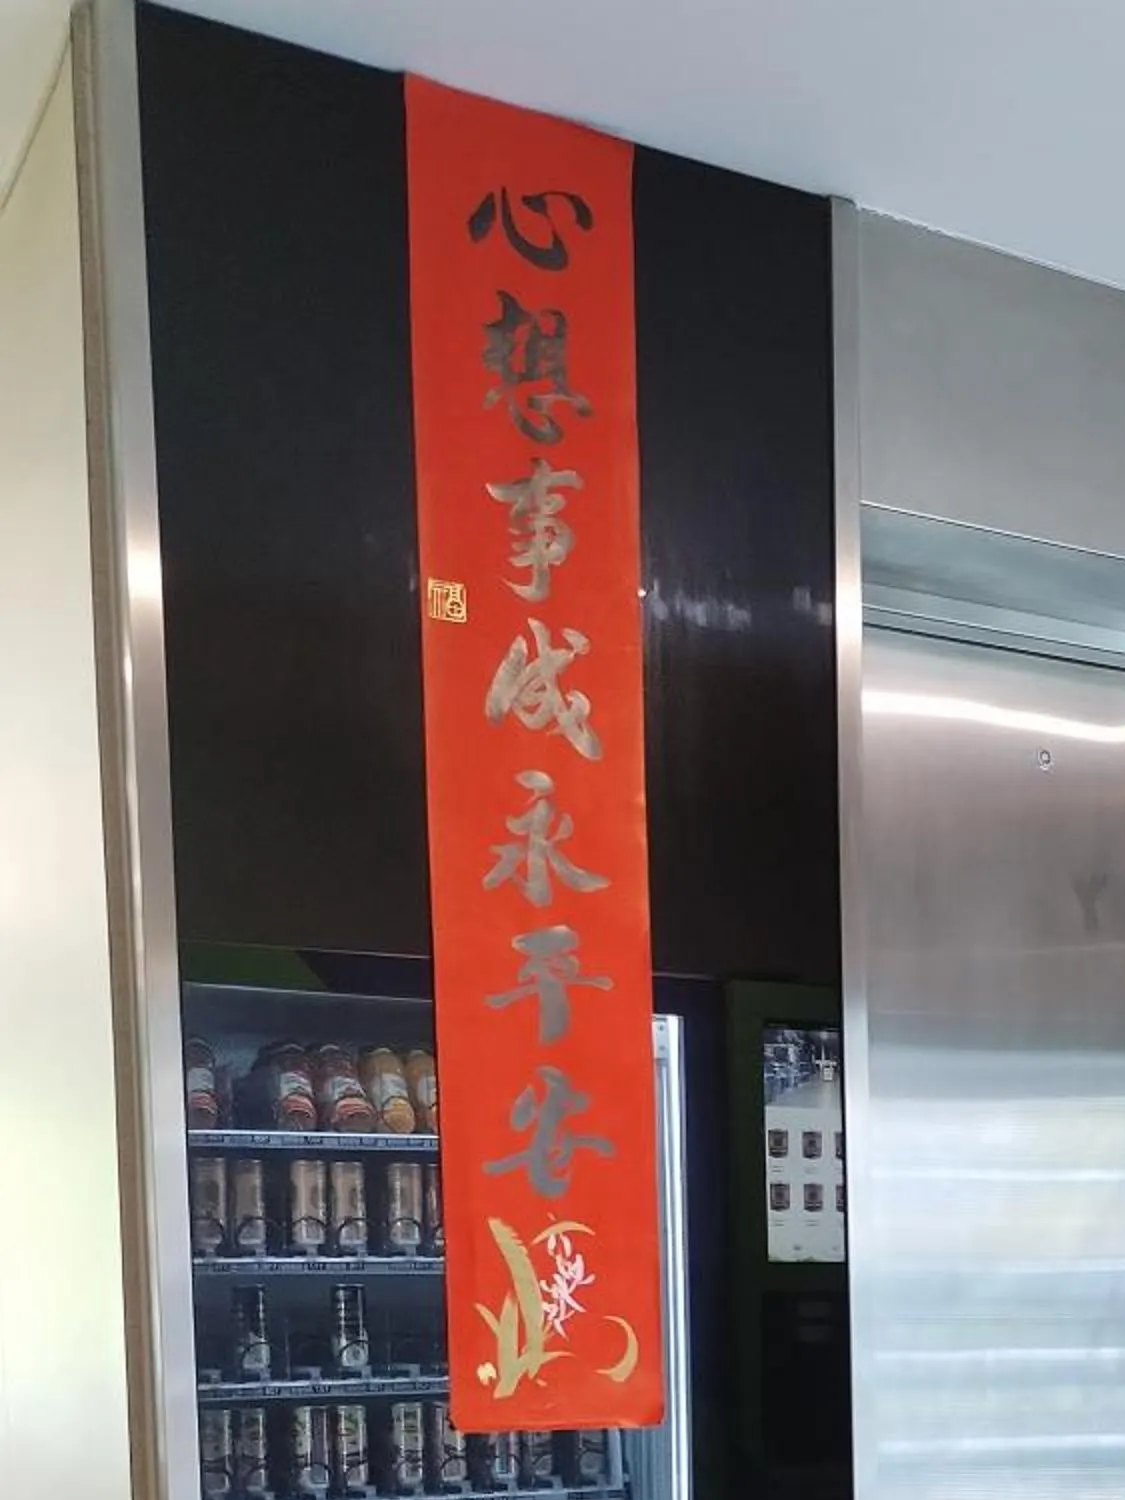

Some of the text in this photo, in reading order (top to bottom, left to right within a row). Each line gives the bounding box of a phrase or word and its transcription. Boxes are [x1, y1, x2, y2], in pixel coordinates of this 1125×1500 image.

[466, 185, 616, 1199] 心想事成永平安
